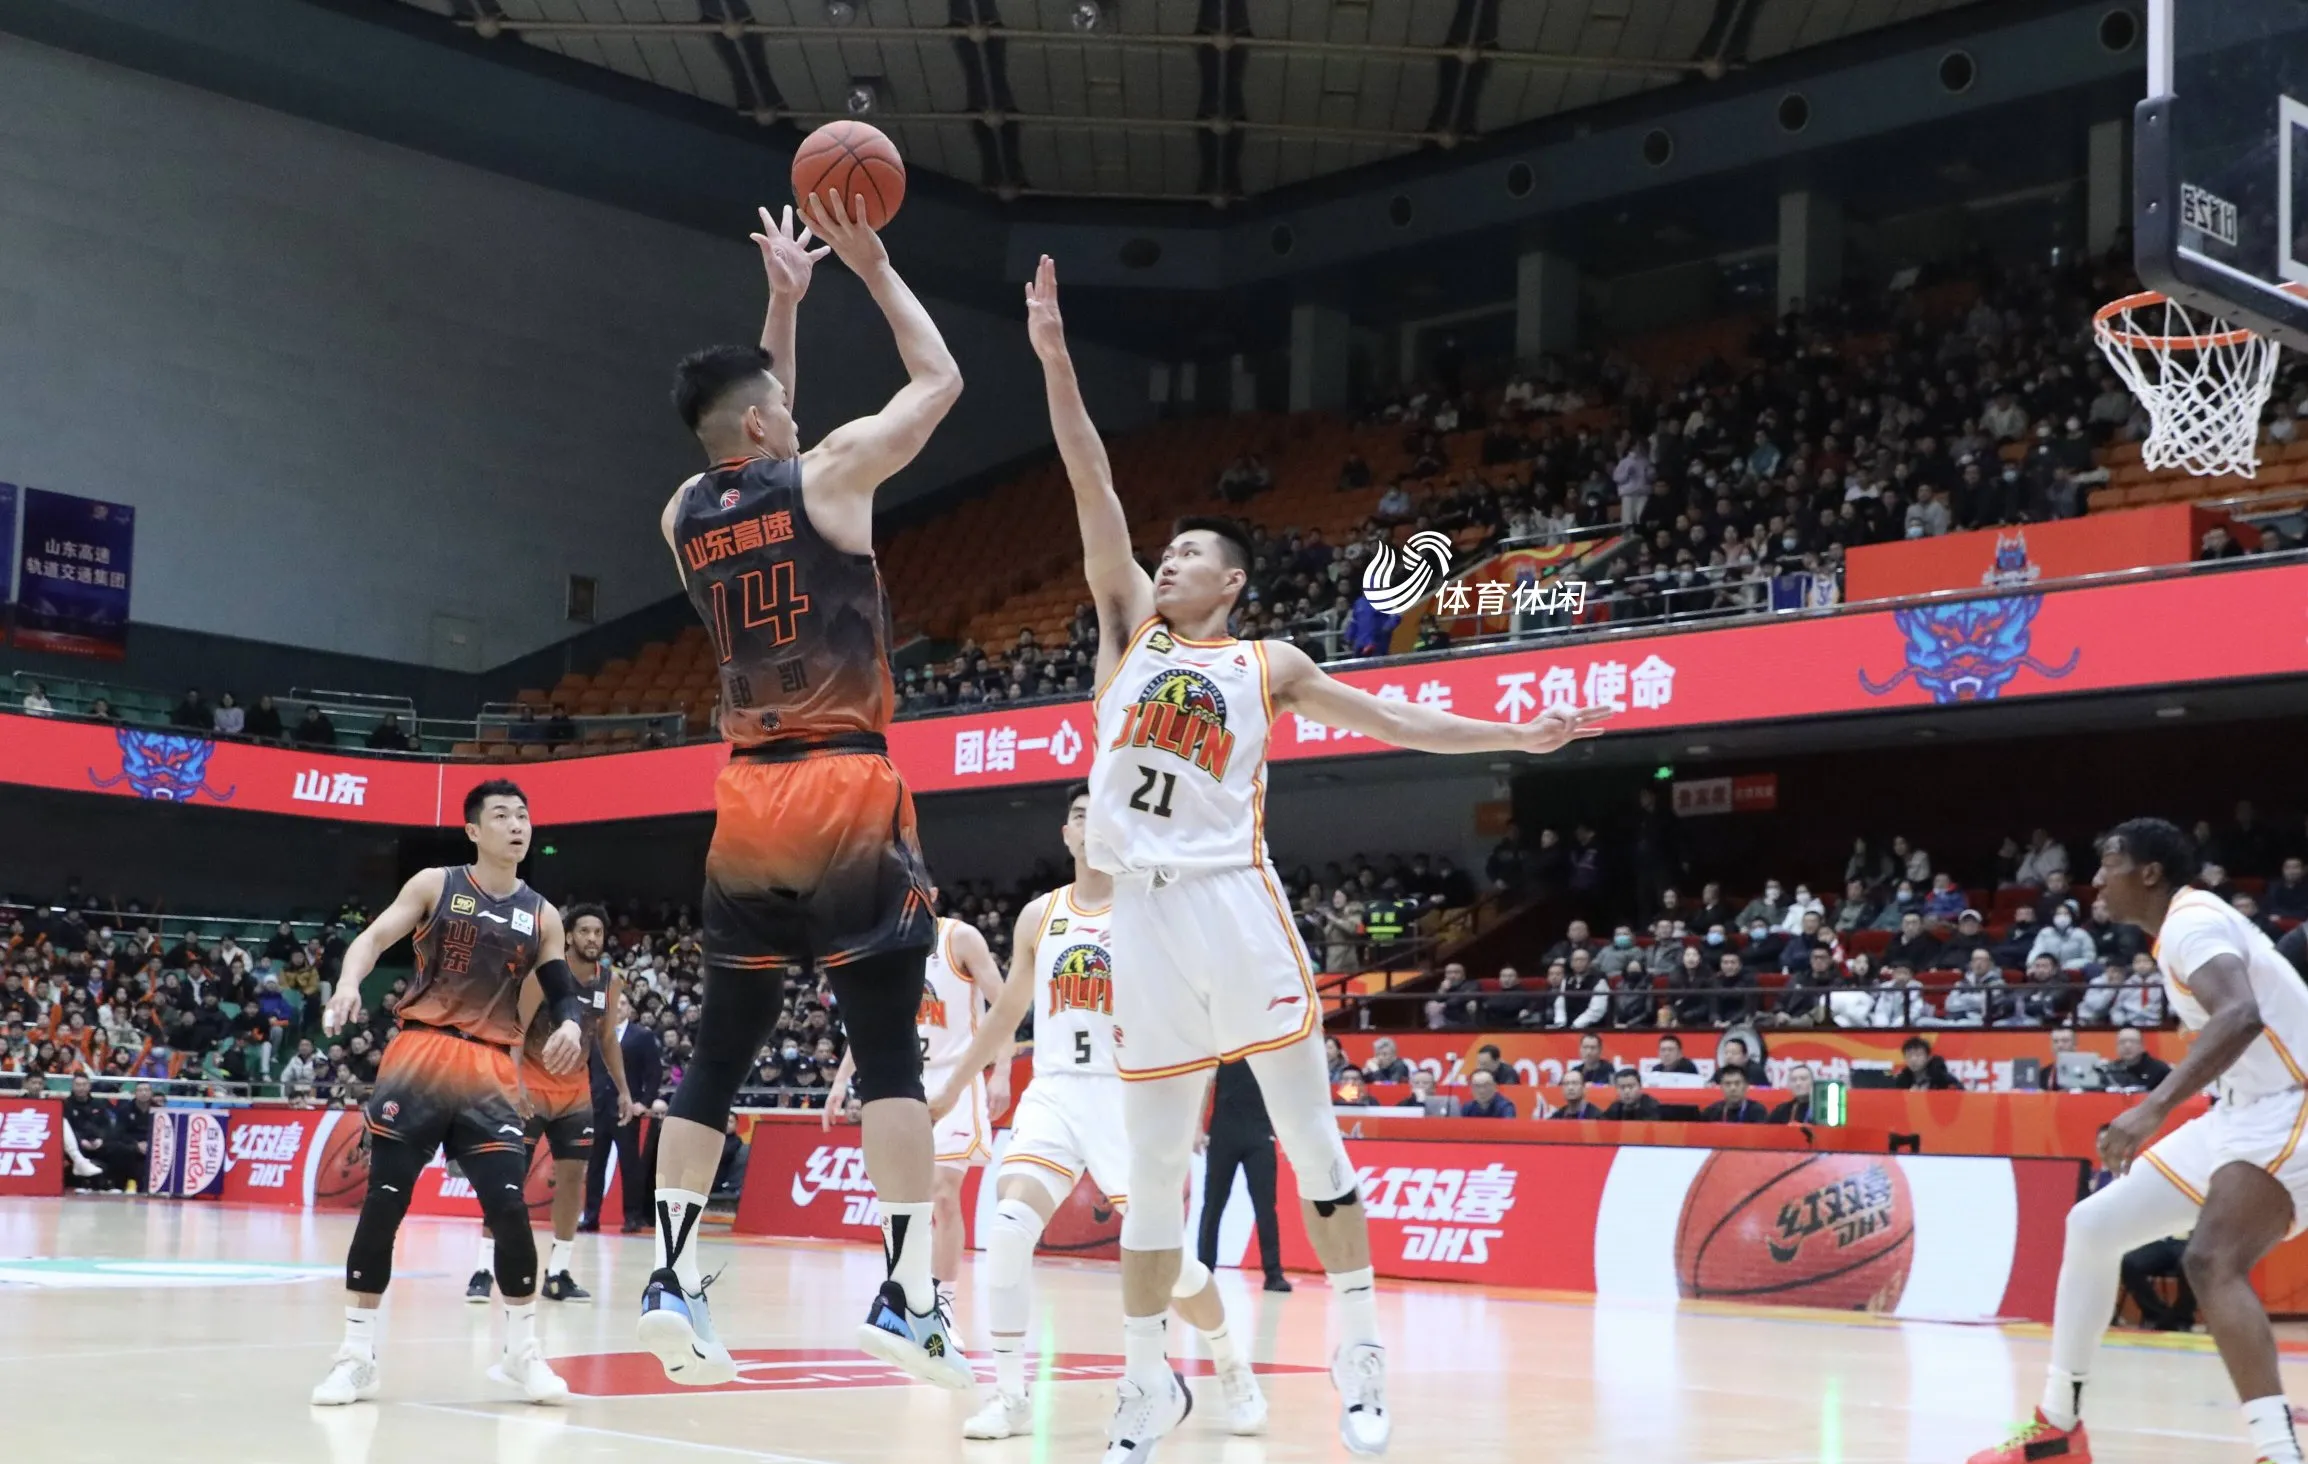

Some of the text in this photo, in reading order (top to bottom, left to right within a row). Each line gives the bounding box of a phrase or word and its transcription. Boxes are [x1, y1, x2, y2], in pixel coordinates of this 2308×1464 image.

[45, 537, 110, 565] 山东高速
[684, 510, 795, 572] 山东高速
[26, 557, 126, 589] 轨道交通集团
[709, 560, 810, 664] 14
[954, 718, 1083, 776] 团结一心
[1494, 653, 1677, 724] 不负使命
[1109, 700, 1236, 783] JILIN
[292, 768, 368, 806] 山东
[1129, 764, 1177, 818] 21
[1075, 1030, 1091, 1064] 5
[230, 1121, 304, 1161] 红双喜
[248, 1162, 292, 1187] DHS
[1355, 1162, 1519, 1225] 红双喜
[1401, 1225, 1504, 1265] DHS
